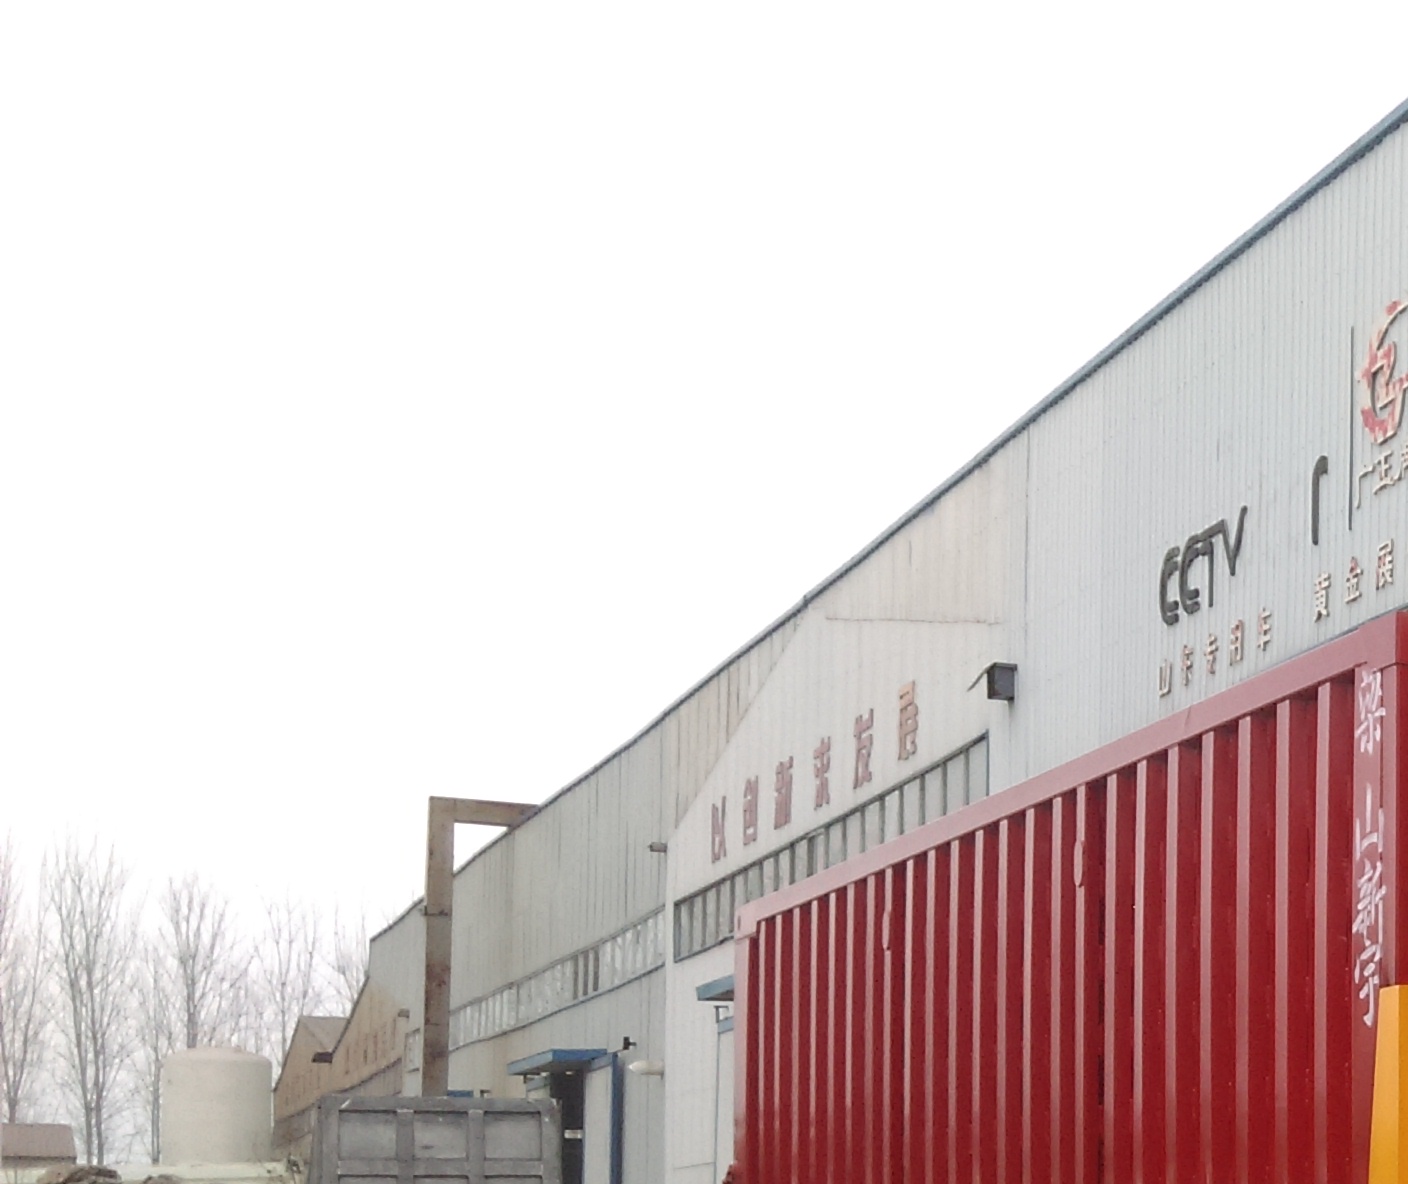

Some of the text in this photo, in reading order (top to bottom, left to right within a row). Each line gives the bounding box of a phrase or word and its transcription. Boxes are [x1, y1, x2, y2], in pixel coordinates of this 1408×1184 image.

[1159, 504, 1249, 626] CCTV
[711, 680, 919, 864] 以创新求发展
